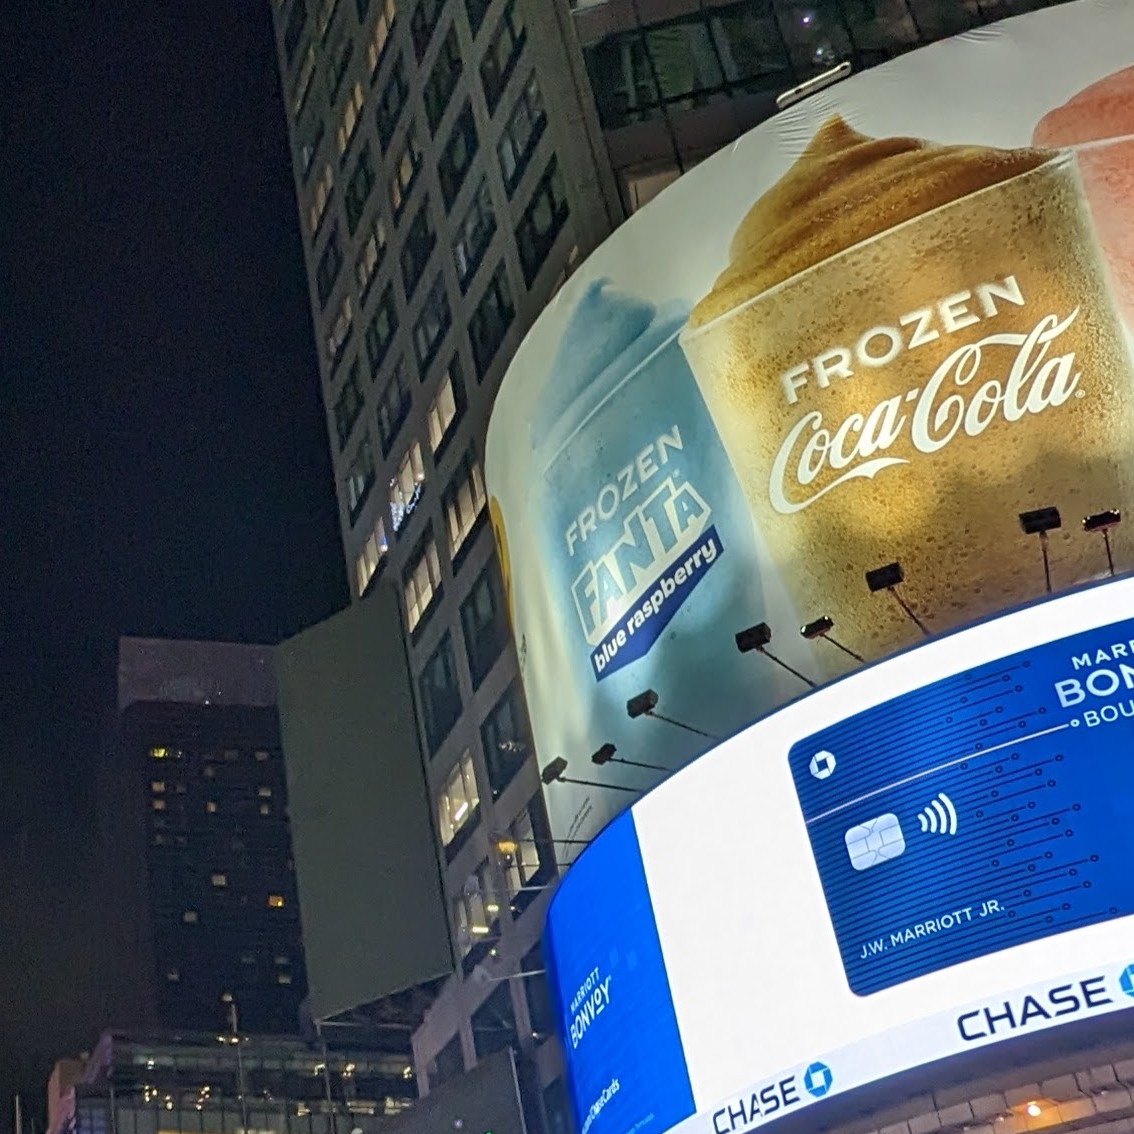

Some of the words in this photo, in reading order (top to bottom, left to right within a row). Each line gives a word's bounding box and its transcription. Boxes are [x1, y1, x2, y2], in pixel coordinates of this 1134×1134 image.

[781, 275, 1025, 404] FROZEN
[769, 305, 1081, 514] Coca-Cola
[565, 424, 683, 556] FROZEN
[571, 476, 712, 645] FANTA
[594, 628, 627, 672] blue
[627, 538, 717, 635] raspberry
[570, 967, 600, 1012] MARRIOTT
[860, 939, 888, 959] J.W.
[890, 907, 972, 946] MARRIOTT
[979, 900, 1005, 917] JR.
[569, 976, 611, 1049] BONVOY
[957, 975, 1114, 1042] CHASE
